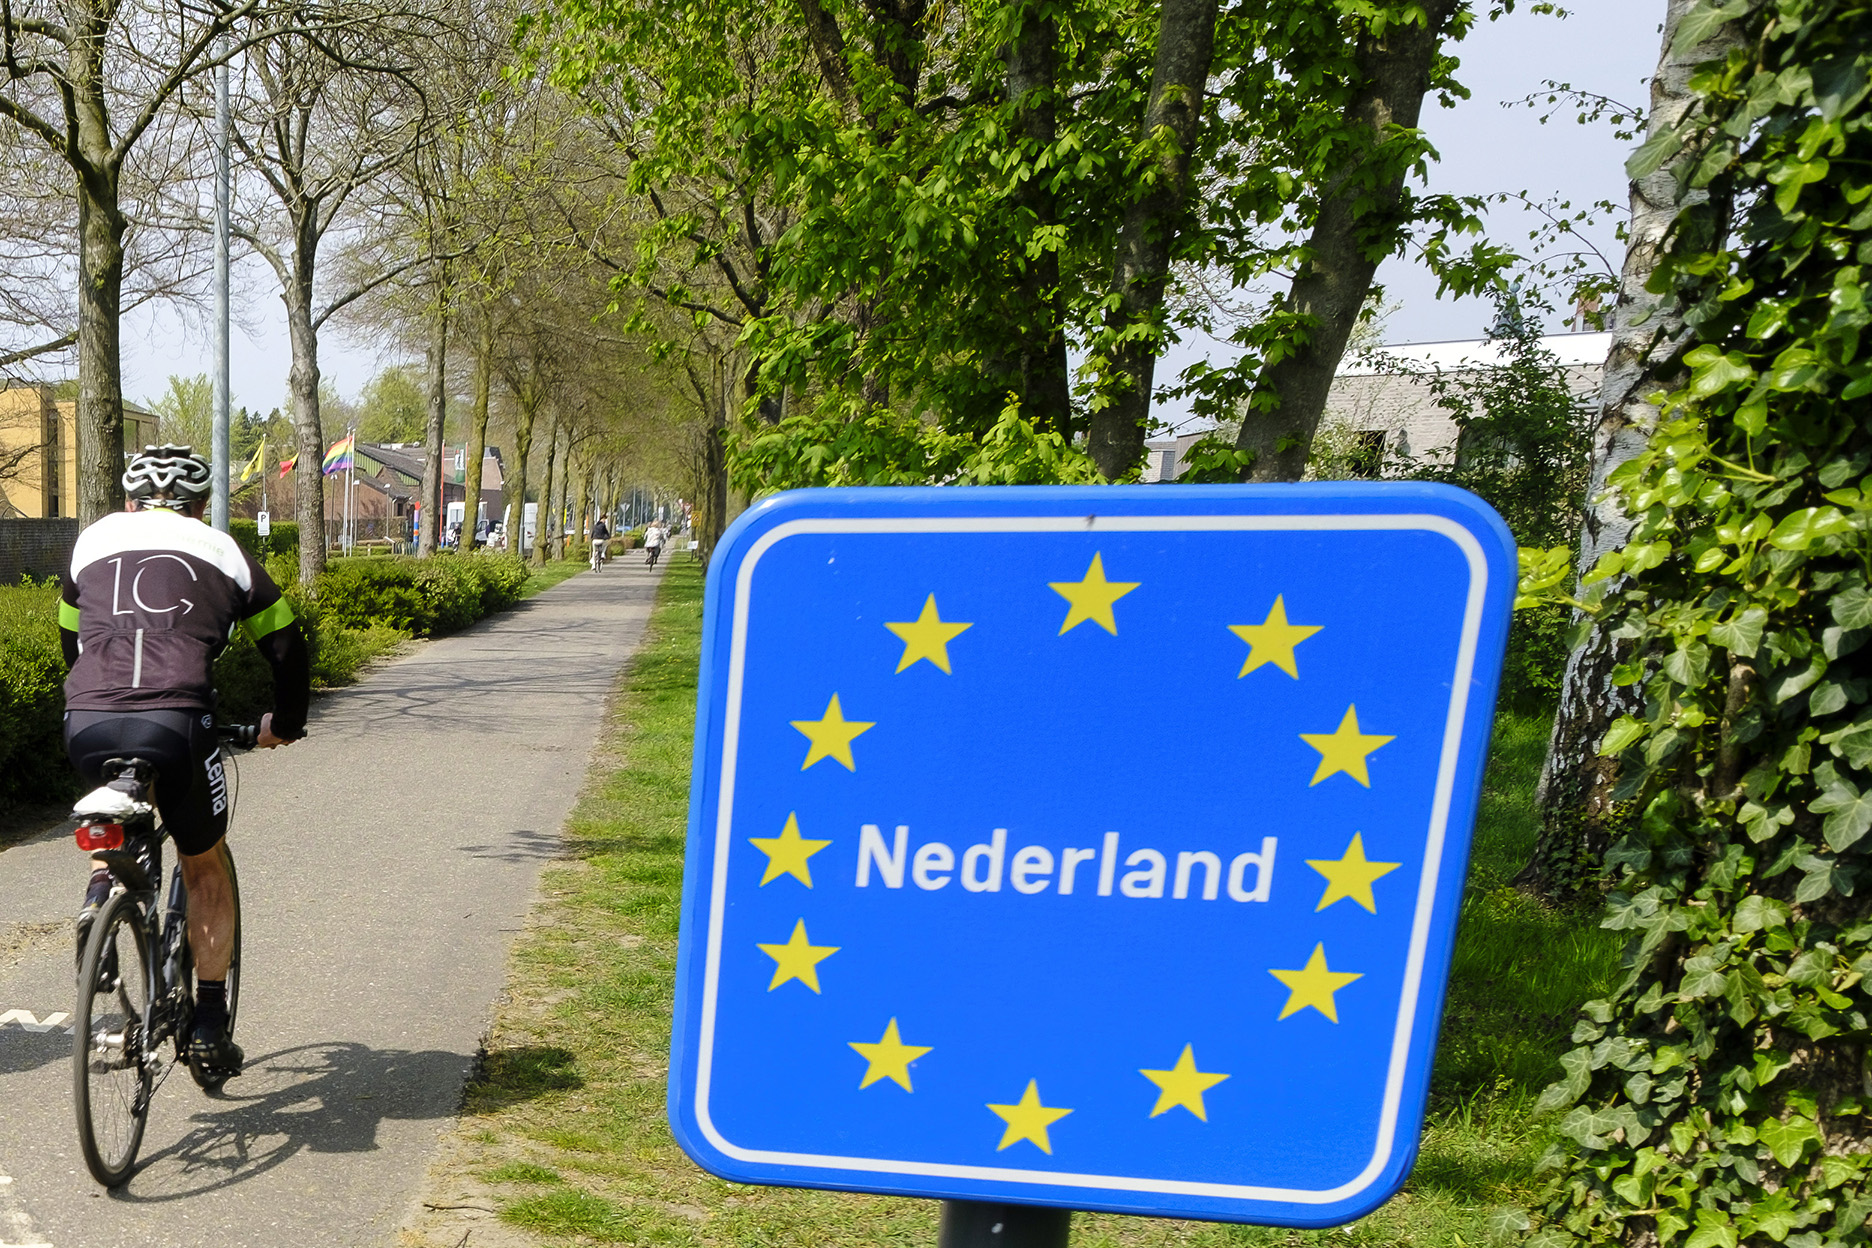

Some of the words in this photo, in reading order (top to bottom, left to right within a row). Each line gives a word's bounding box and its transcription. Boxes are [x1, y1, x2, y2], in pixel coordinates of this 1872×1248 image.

[261, 514, 266, 522] P
[204, 746, 227, 816] Lema
[855, 824, 1278, 903] Nederland
